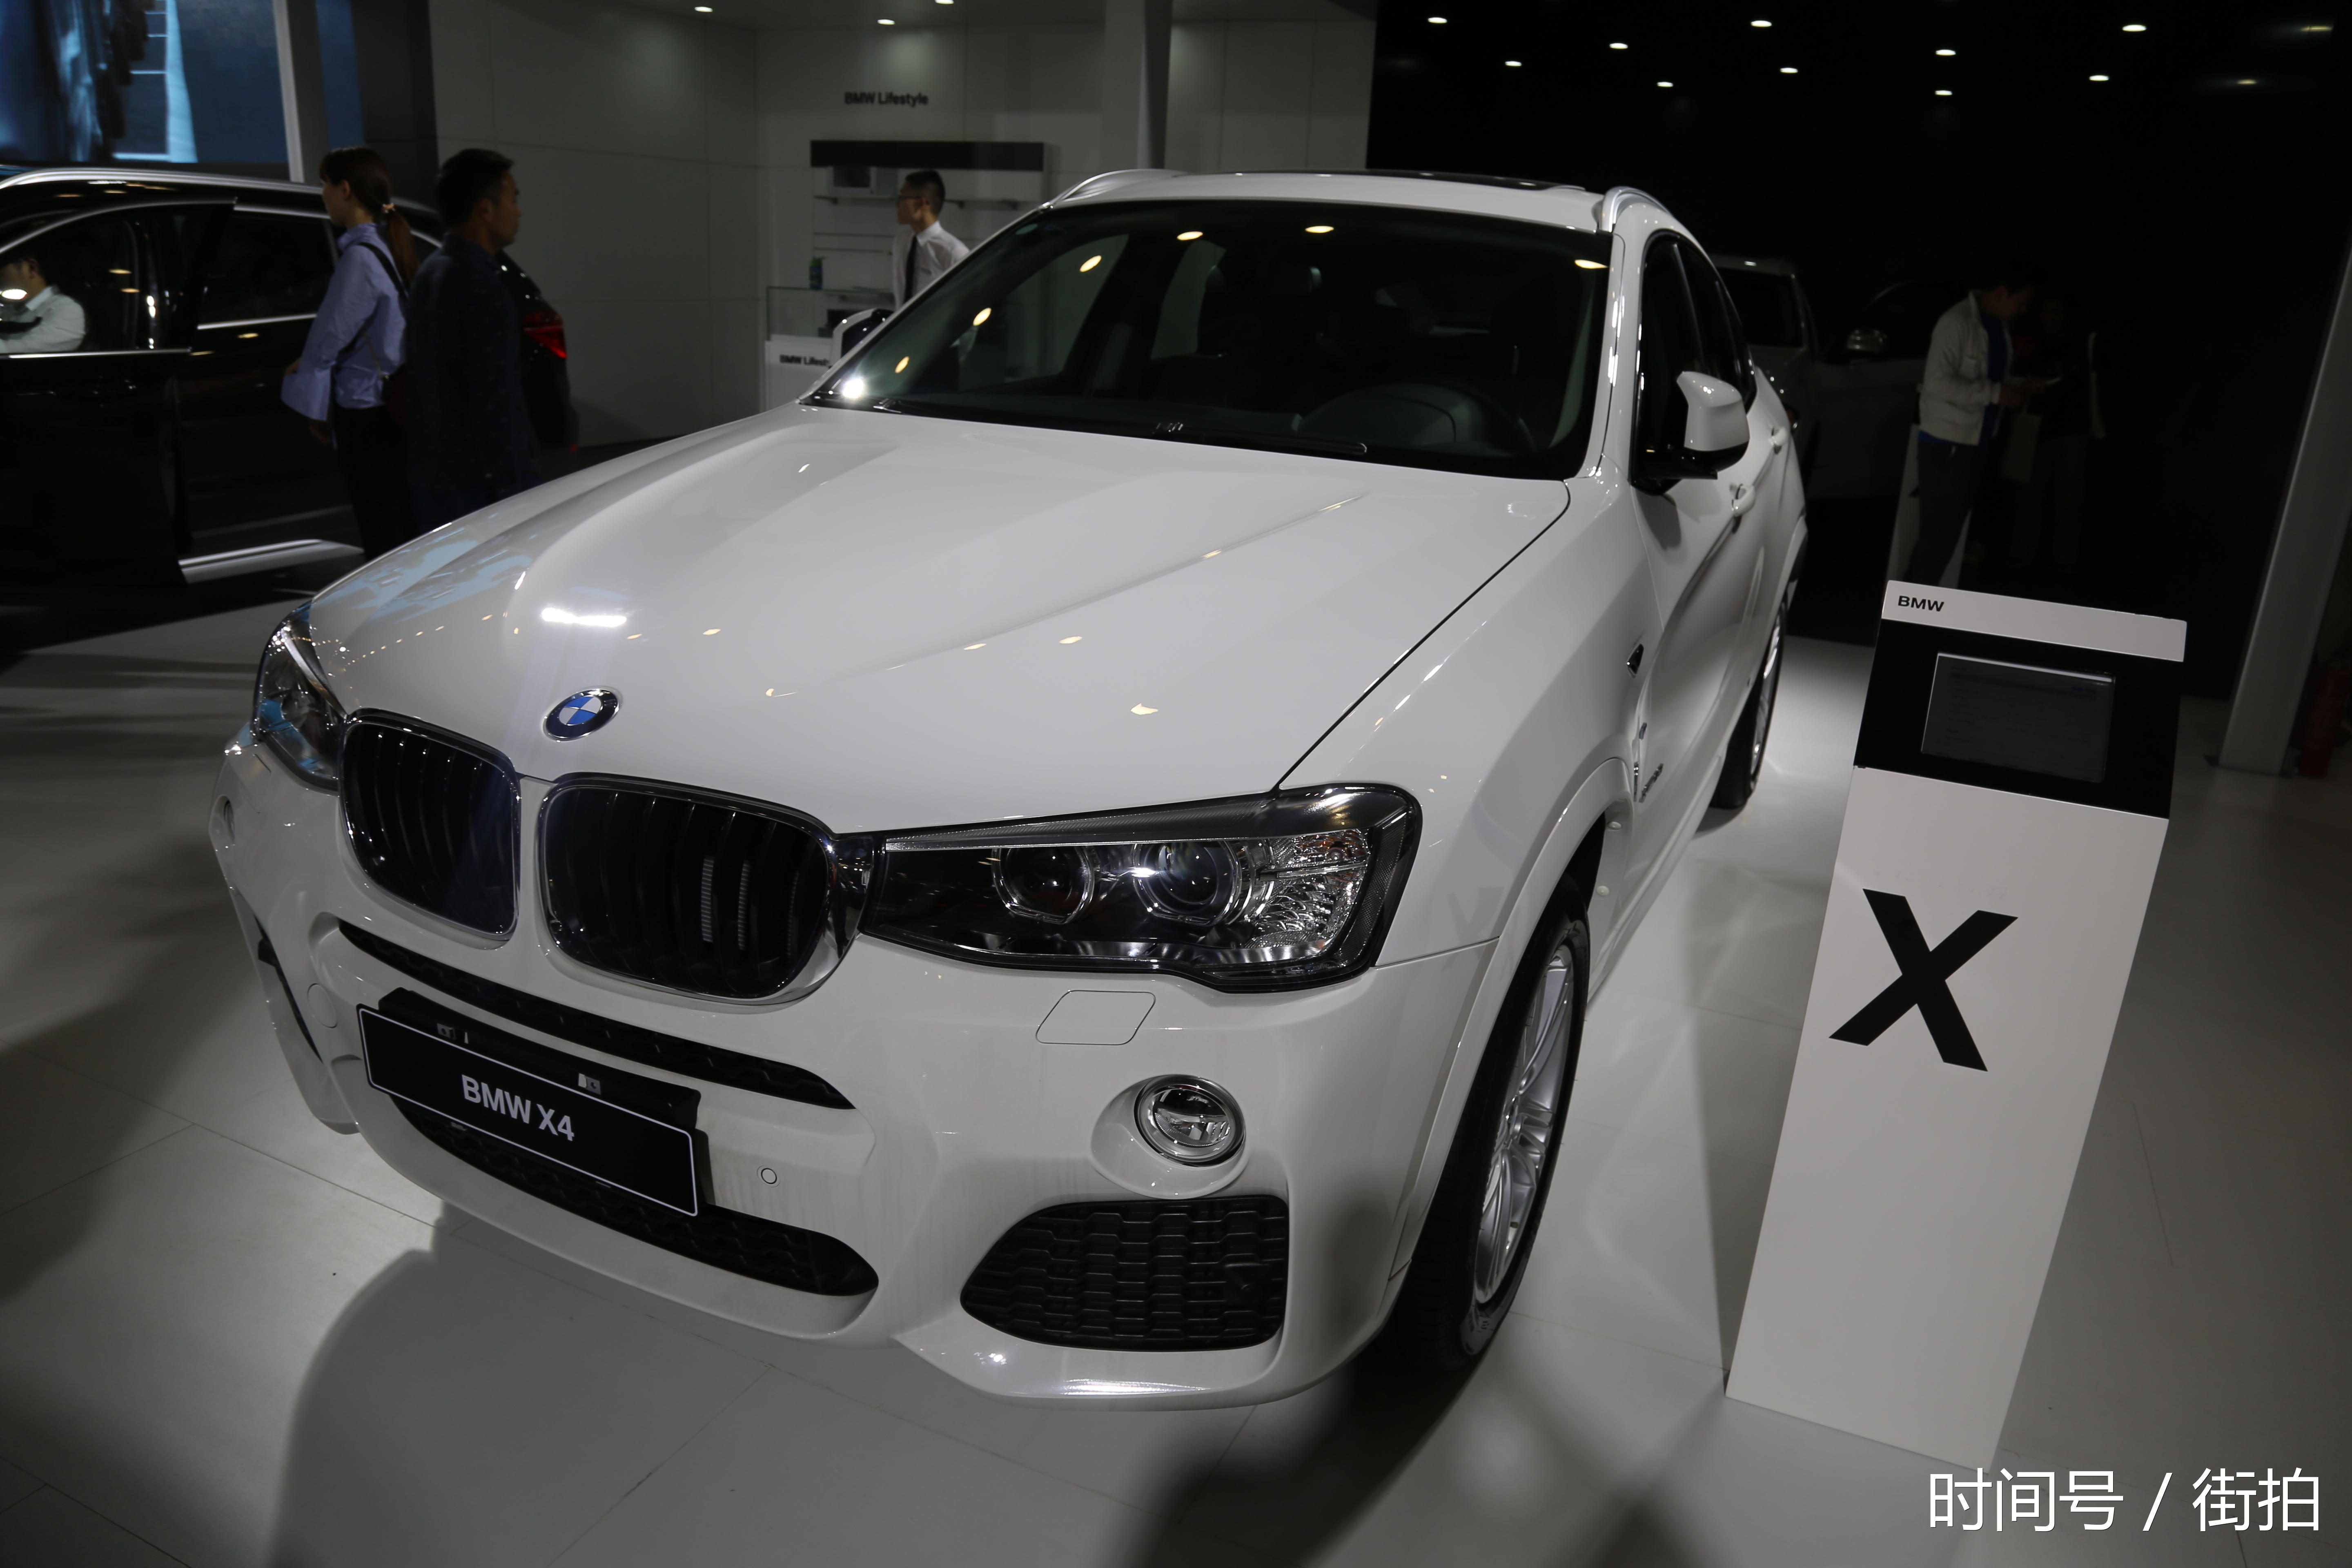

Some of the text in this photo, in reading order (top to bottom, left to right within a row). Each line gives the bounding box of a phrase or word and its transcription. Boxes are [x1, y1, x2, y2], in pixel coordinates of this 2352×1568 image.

[845, 92, 928, 107] BMW Lifestyle
[780, 355, 831, 368] BMW Lifest
[1898, 595, 1945, 612] BMW
[1829, 889, 2018, 1071] X
[461, 1074, 575, 1141] BMW X4
